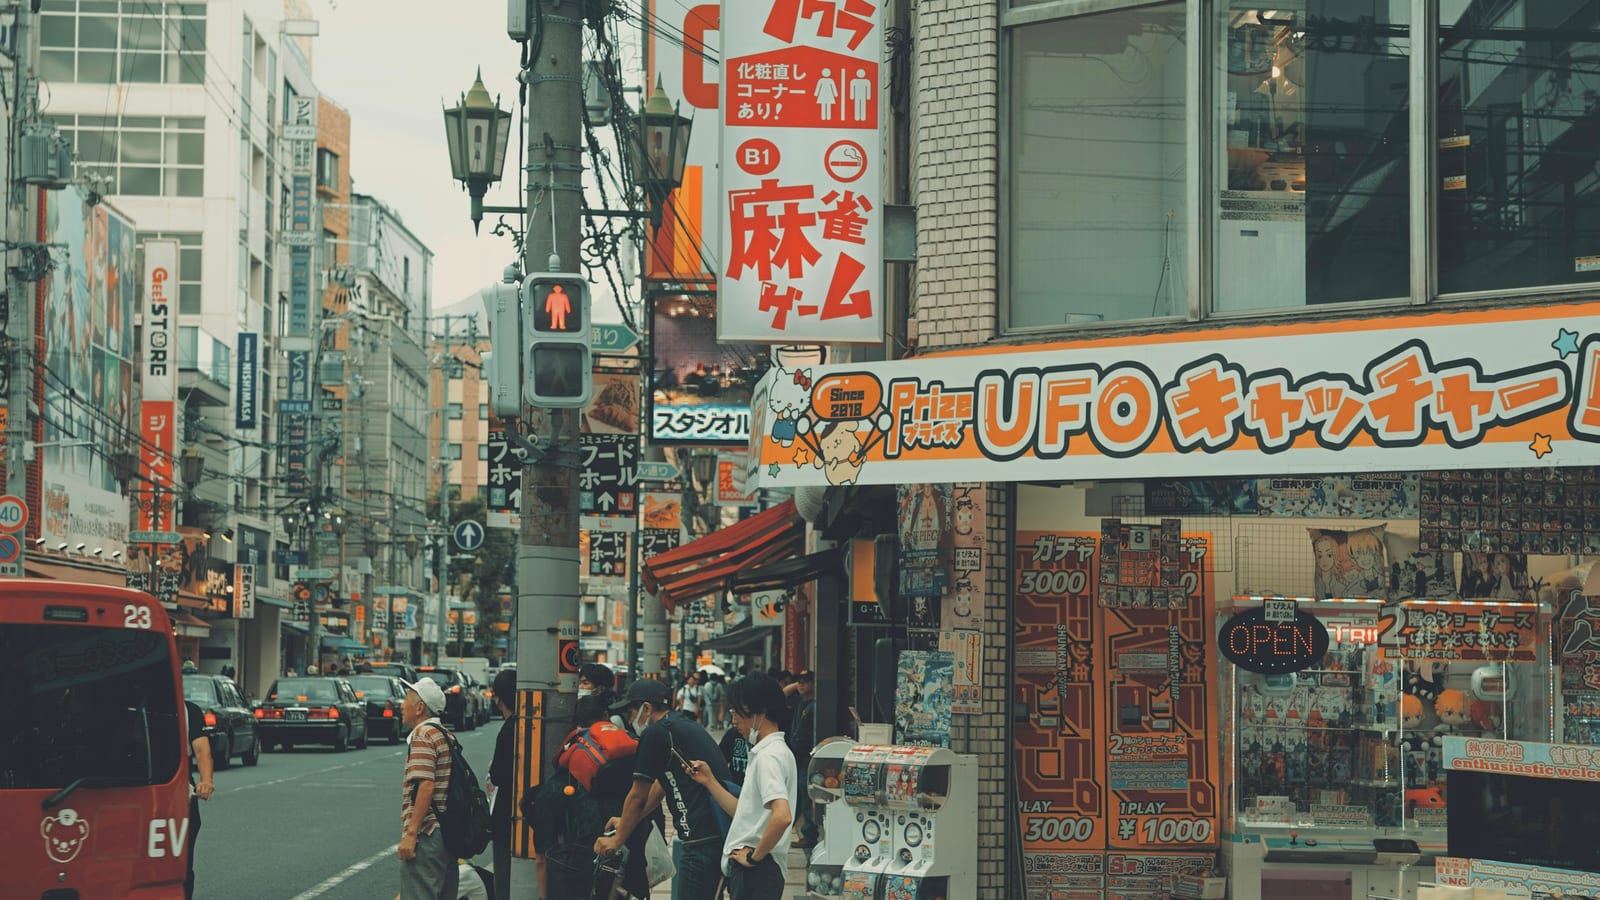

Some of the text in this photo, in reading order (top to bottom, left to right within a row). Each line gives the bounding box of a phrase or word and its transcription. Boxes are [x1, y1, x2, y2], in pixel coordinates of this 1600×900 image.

[737, 63, 807, 80] 化粧直し
[737, 83, 806, 99] コーナー
[737, 102, 783, 120] あり!
[744, 149, 770, 165] B1
[725, 179, 874, 281] 麻雀
[758, 251, 873, 330] ゲーム
[830, 388, 865, 401] Since
[830, 403, 863, 417] 2018
[887, 382, 974, 454] Prize
[903, 422, 962, 446] プライズ
[581, 443, 635, 468] フード
[579, 467, 639, 490] ホール
[0, 506, 20, 522] 40
[591, 532, 624, 547] フード
[1134, 531, 1145, 543] 8
[591, 547, 625, 560] ホール
[1032, 537, 1095, 562] ガチャ
[1021, 572, 1085, 594] 3000
[123, 604, 152, 629] 23
[1229, 624, 1314, 656] OPEN
[1453, 758, 1600, 779] enthusiastic welc
[148, 817, 188, 858] EV
[1025, 818, 1093, 842] 3000
[1448, 878, 1467, 886] NG
